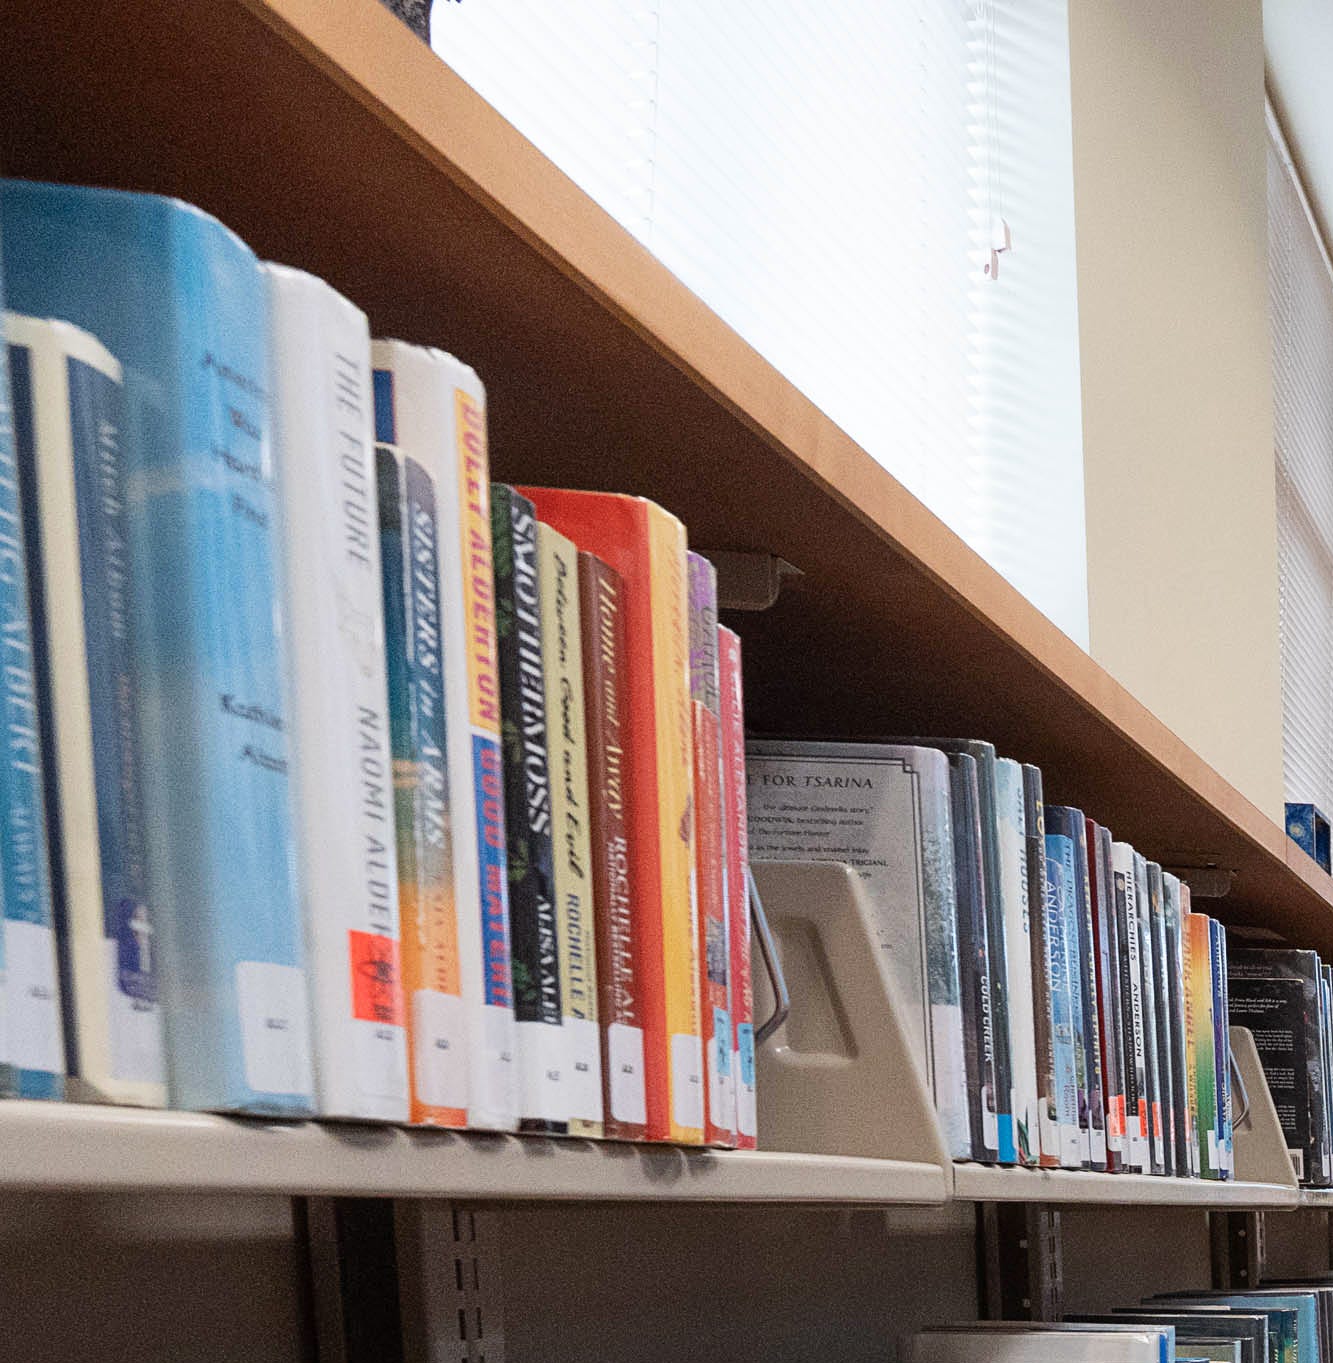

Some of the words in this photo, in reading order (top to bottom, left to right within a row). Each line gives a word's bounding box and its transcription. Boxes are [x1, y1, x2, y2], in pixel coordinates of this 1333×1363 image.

[338, 431, 371, 571] FUTURE
[357, 705, 389, 821] NAOMI
[763, 775, 796, 786] FOR
[804, 776, 873, 789] TSARINA
[1045, 880, 1065, 994] ANDERSON
[1126, 870, 1138, 962] HIERARCHIES
[1132, 983, 1144, 1058] ANDERSON
